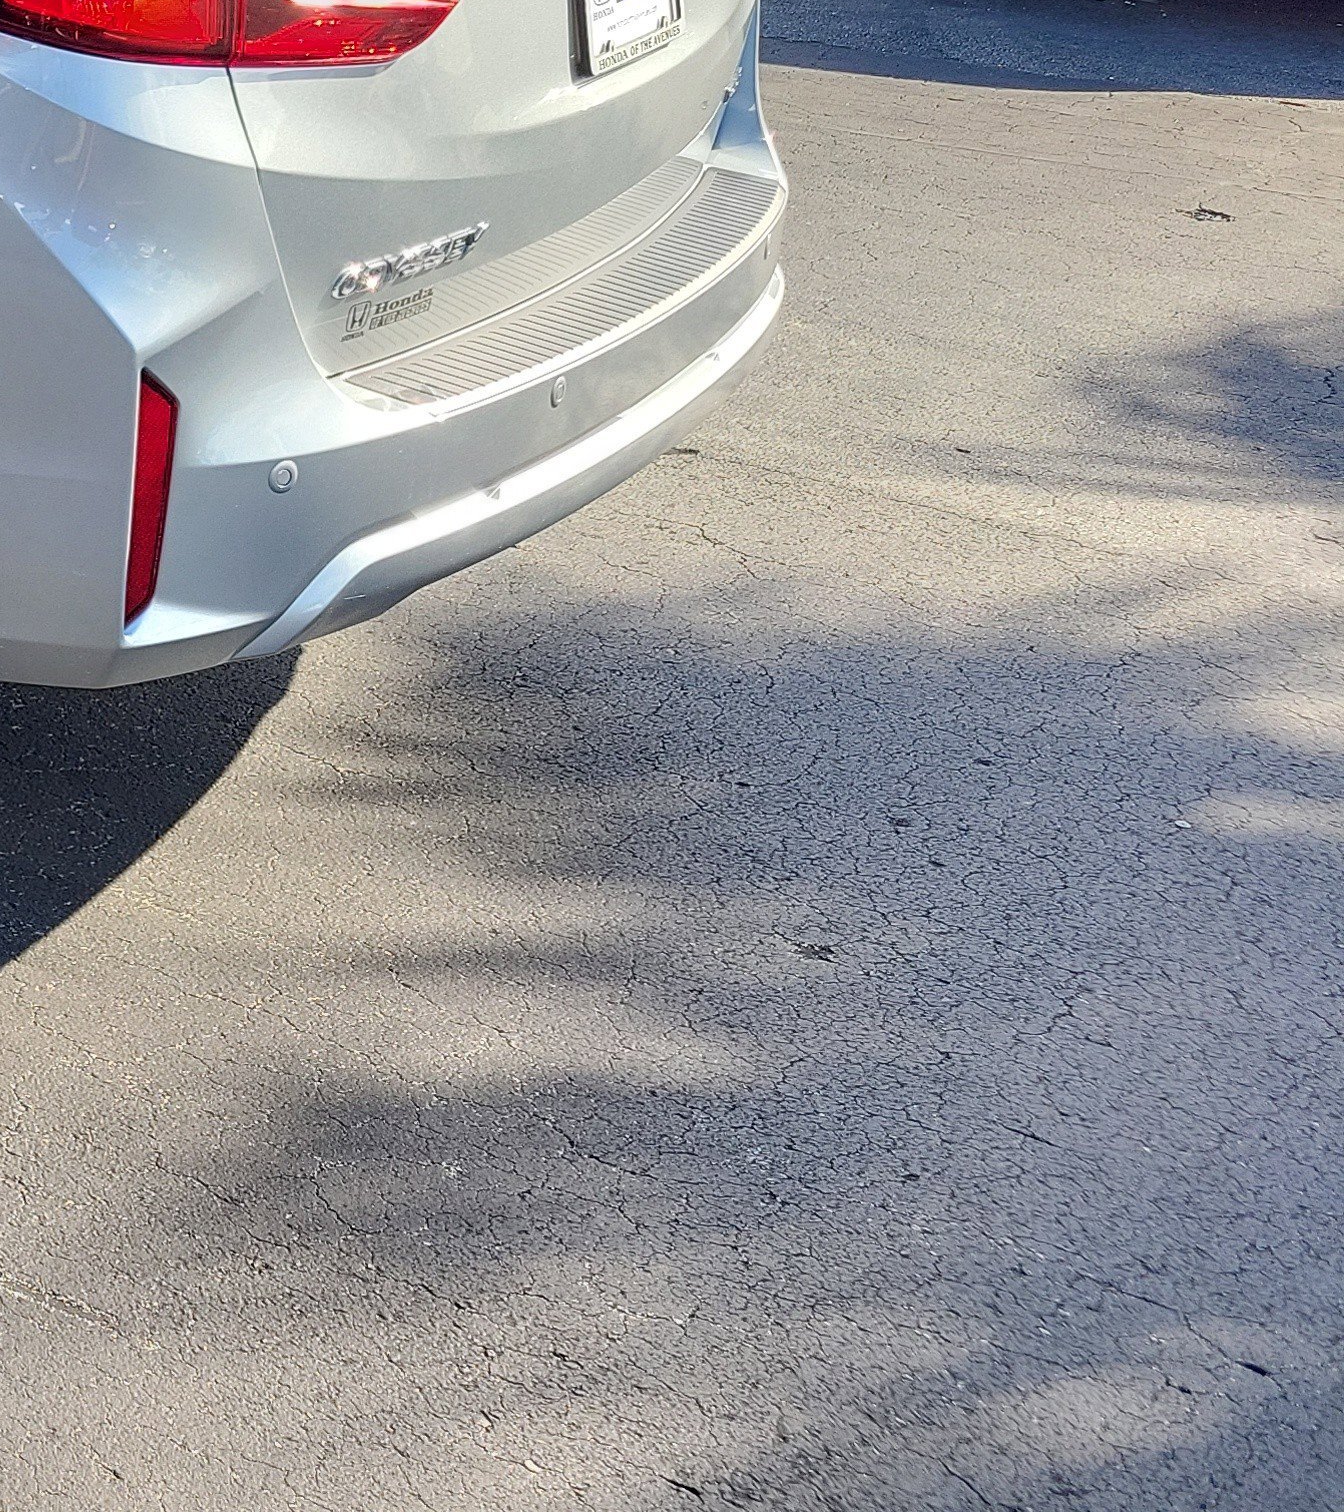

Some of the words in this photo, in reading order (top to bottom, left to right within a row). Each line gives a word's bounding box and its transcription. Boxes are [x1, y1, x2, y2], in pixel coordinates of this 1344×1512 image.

[598, 49, 629, 70] HONDA
[630, 43, 639, 56] OF
[374, 287, 433, 315] Honda
